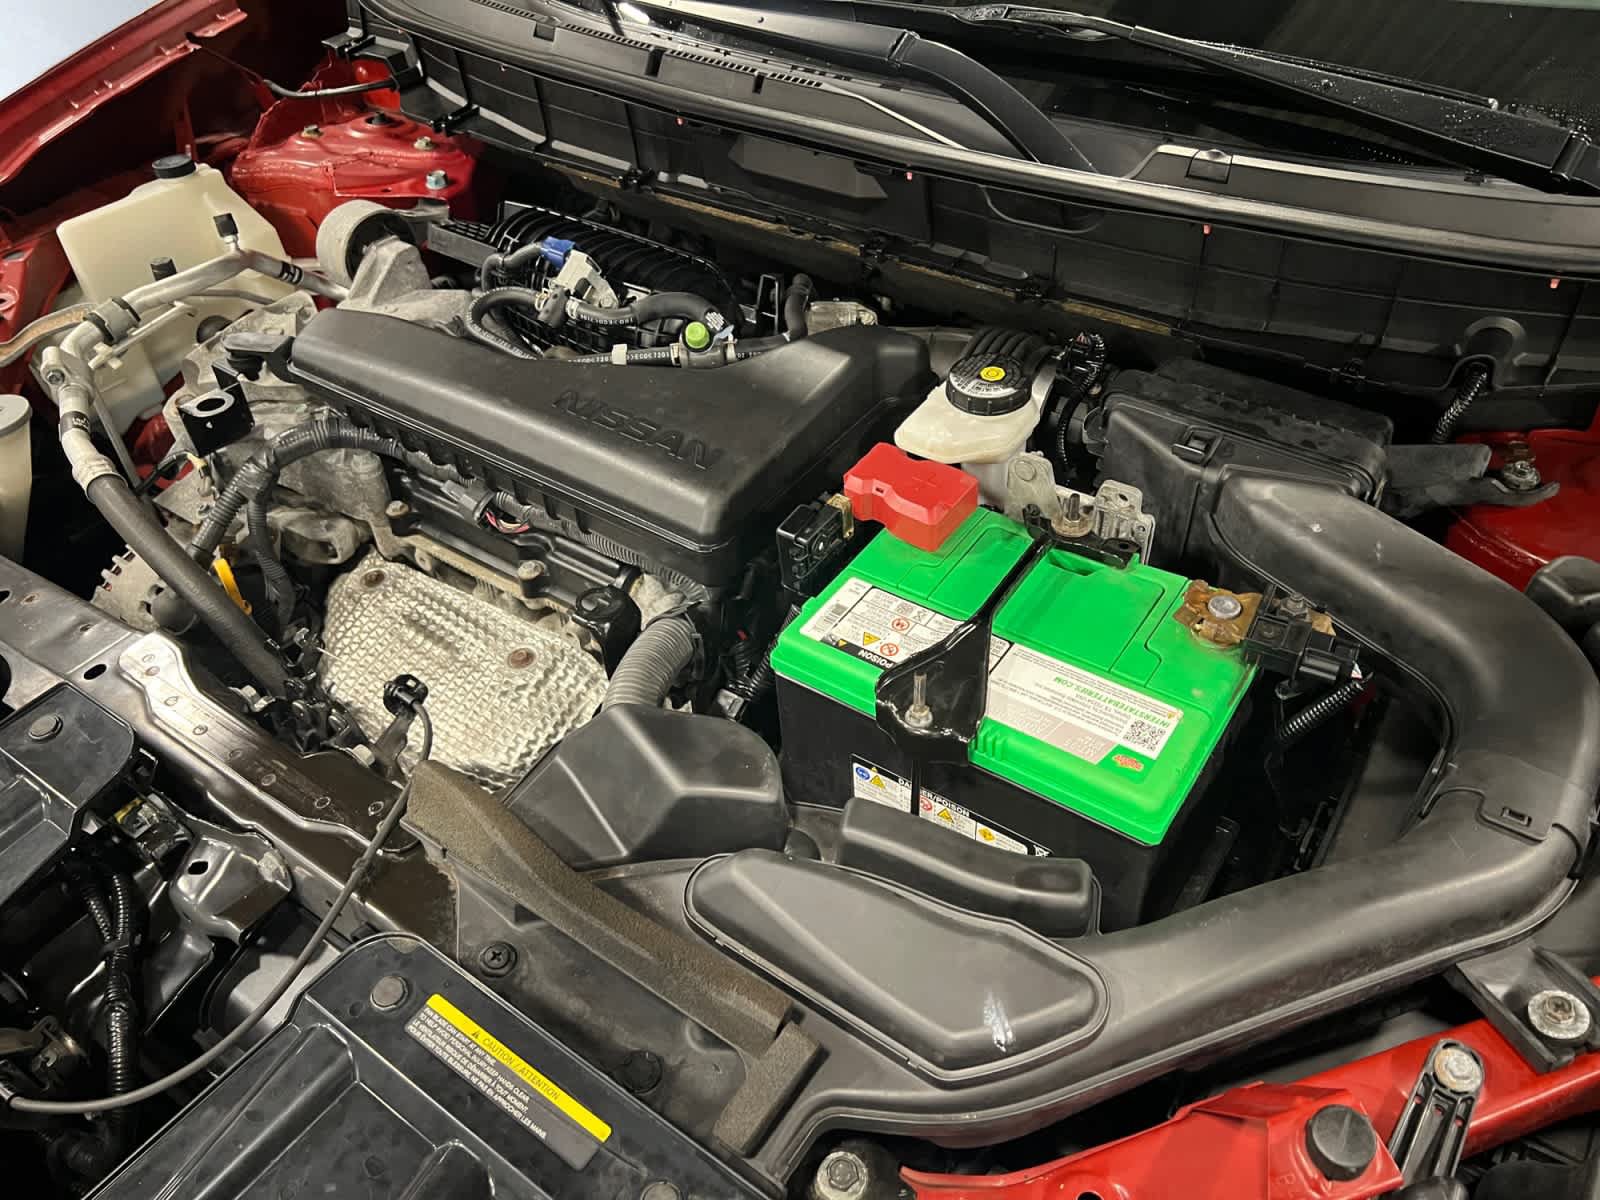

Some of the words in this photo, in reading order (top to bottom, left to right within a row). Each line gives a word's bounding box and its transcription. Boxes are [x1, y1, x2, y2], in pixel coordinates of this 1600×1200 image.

[551, 390, 711, 473] NISSAN
[857, 648, 893, 668] POISON
[1053, 676, 1170, 728] INTERSTATEBATTERIES.COM
[481, 1036, 515, 1066] CAUTION
[518, 1066, 560, 1101] ATTENTION
